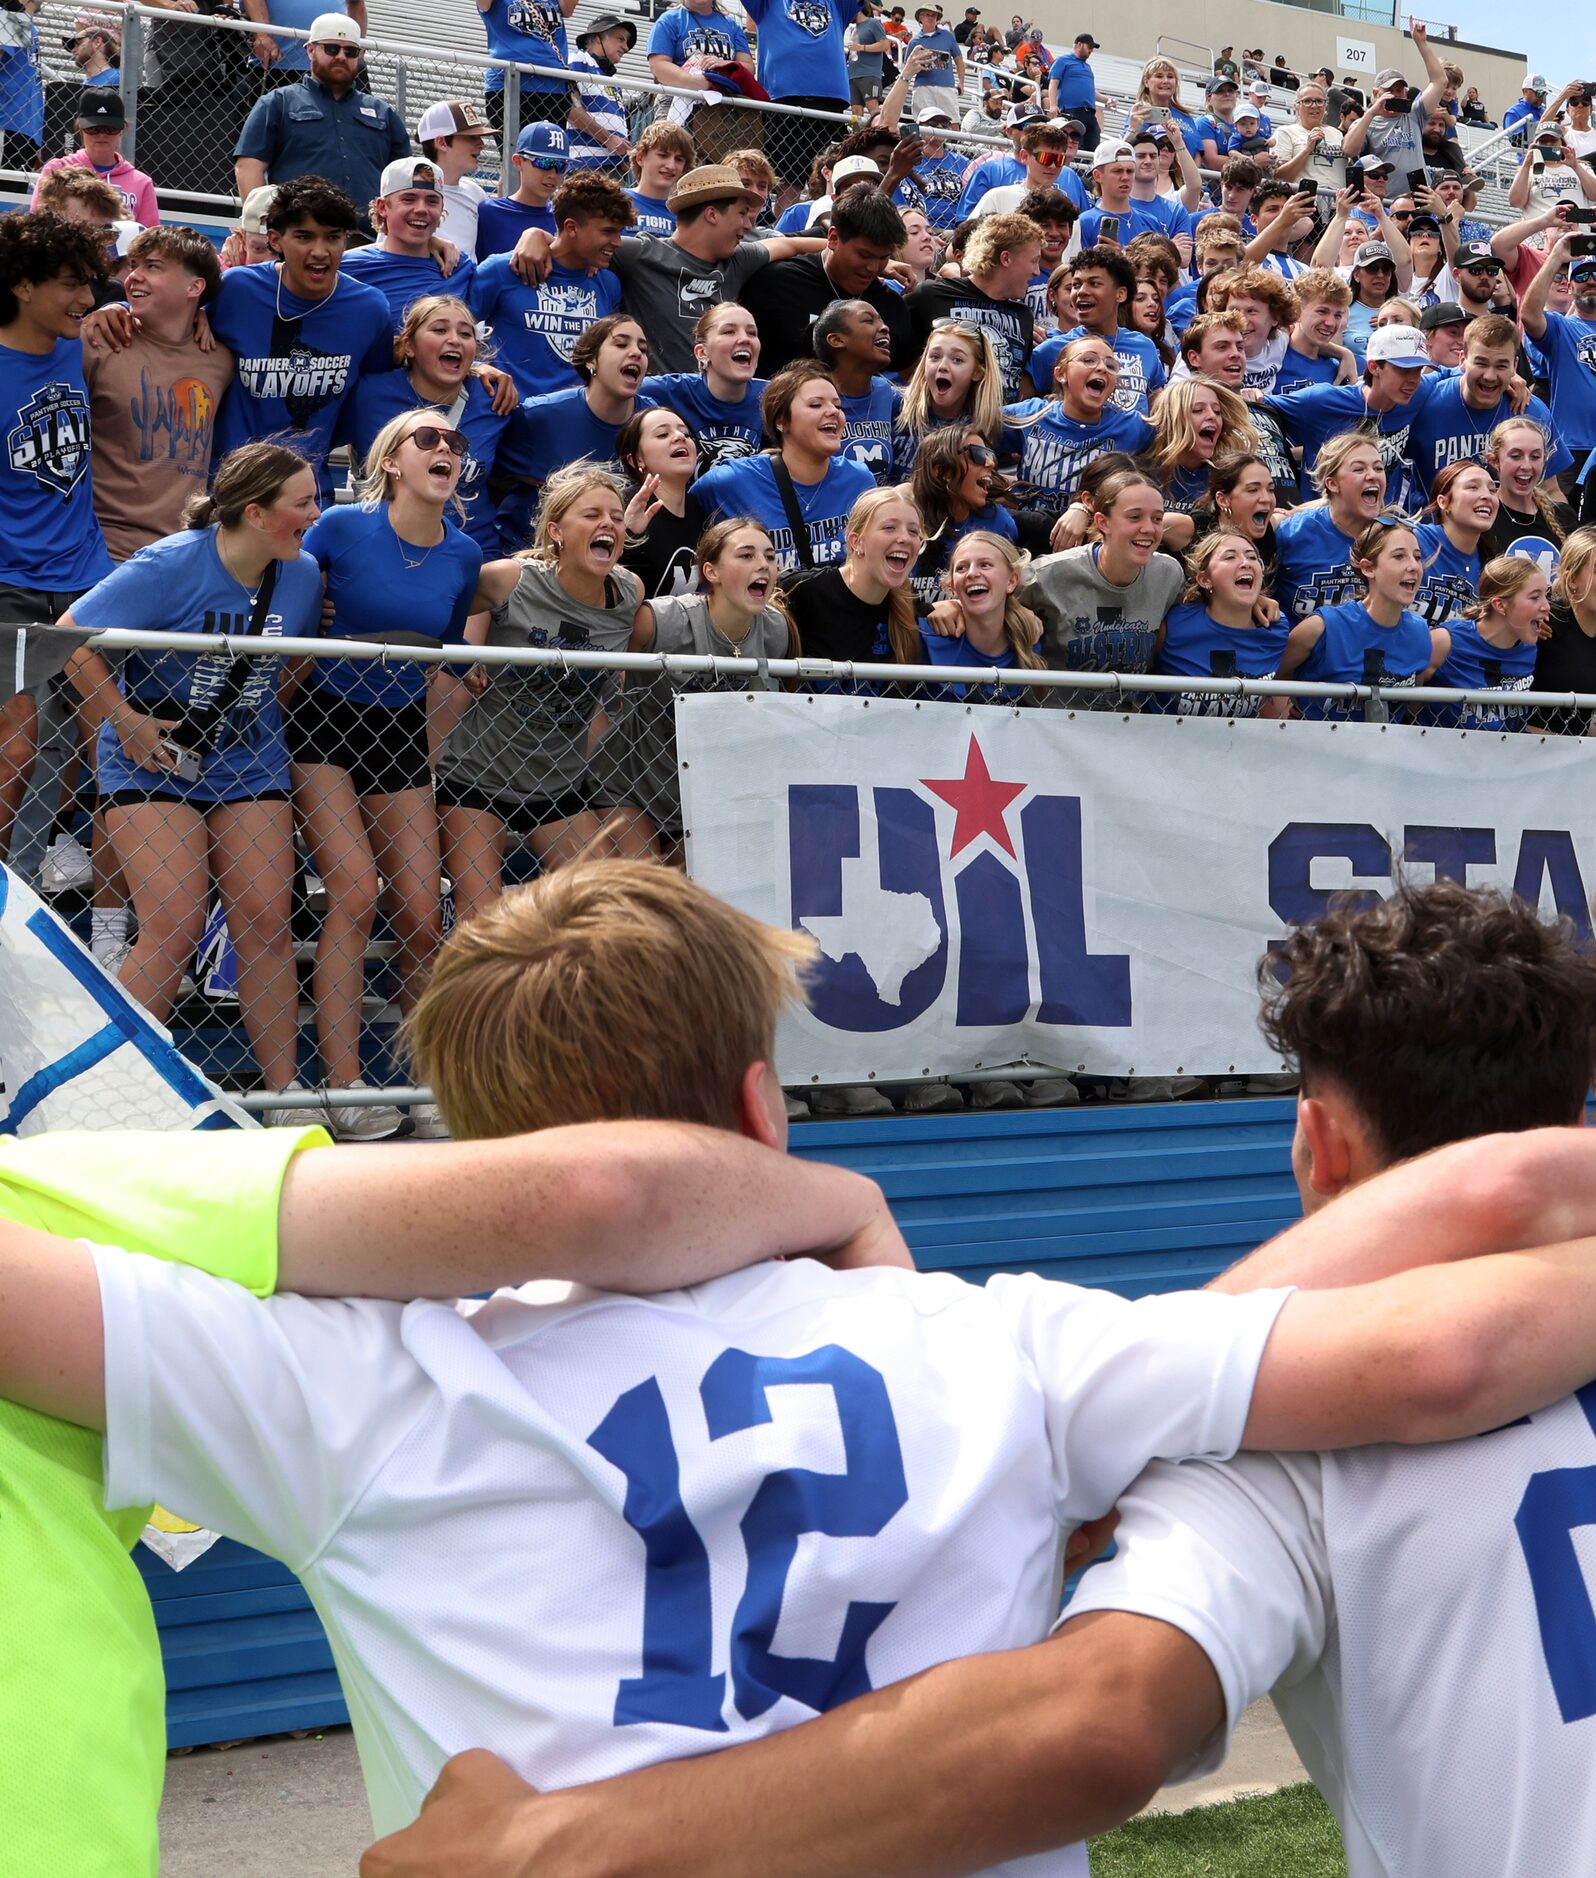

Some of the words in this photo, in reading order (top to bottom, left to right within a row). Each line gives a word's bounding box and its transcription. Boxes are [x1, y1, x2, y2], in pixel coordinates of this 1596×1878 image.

[1346, 48, 1366, 62] 207
[1540, 122, 1556, 130] LOVE
[638, 214, 672, 231] FIGHT
[689, 278, 718, 293] NIKE
[524, 312, 562, 331] WIN
[564, 320, 581, 330] THE
[239, 357, 290, 372] PANTHER
[310, 354, 351, 370] SOCCER
[240, 368, 349, 399] PLAYOFFS
[30, 402, 58, 421] PANTHER
[59, 400, 82, 411] SOCCER
[1321, 578, 1349, 586] PANTHER
[788, 784, 1132, 1033] UIL
[586, 1343, 909, 1731] 12
